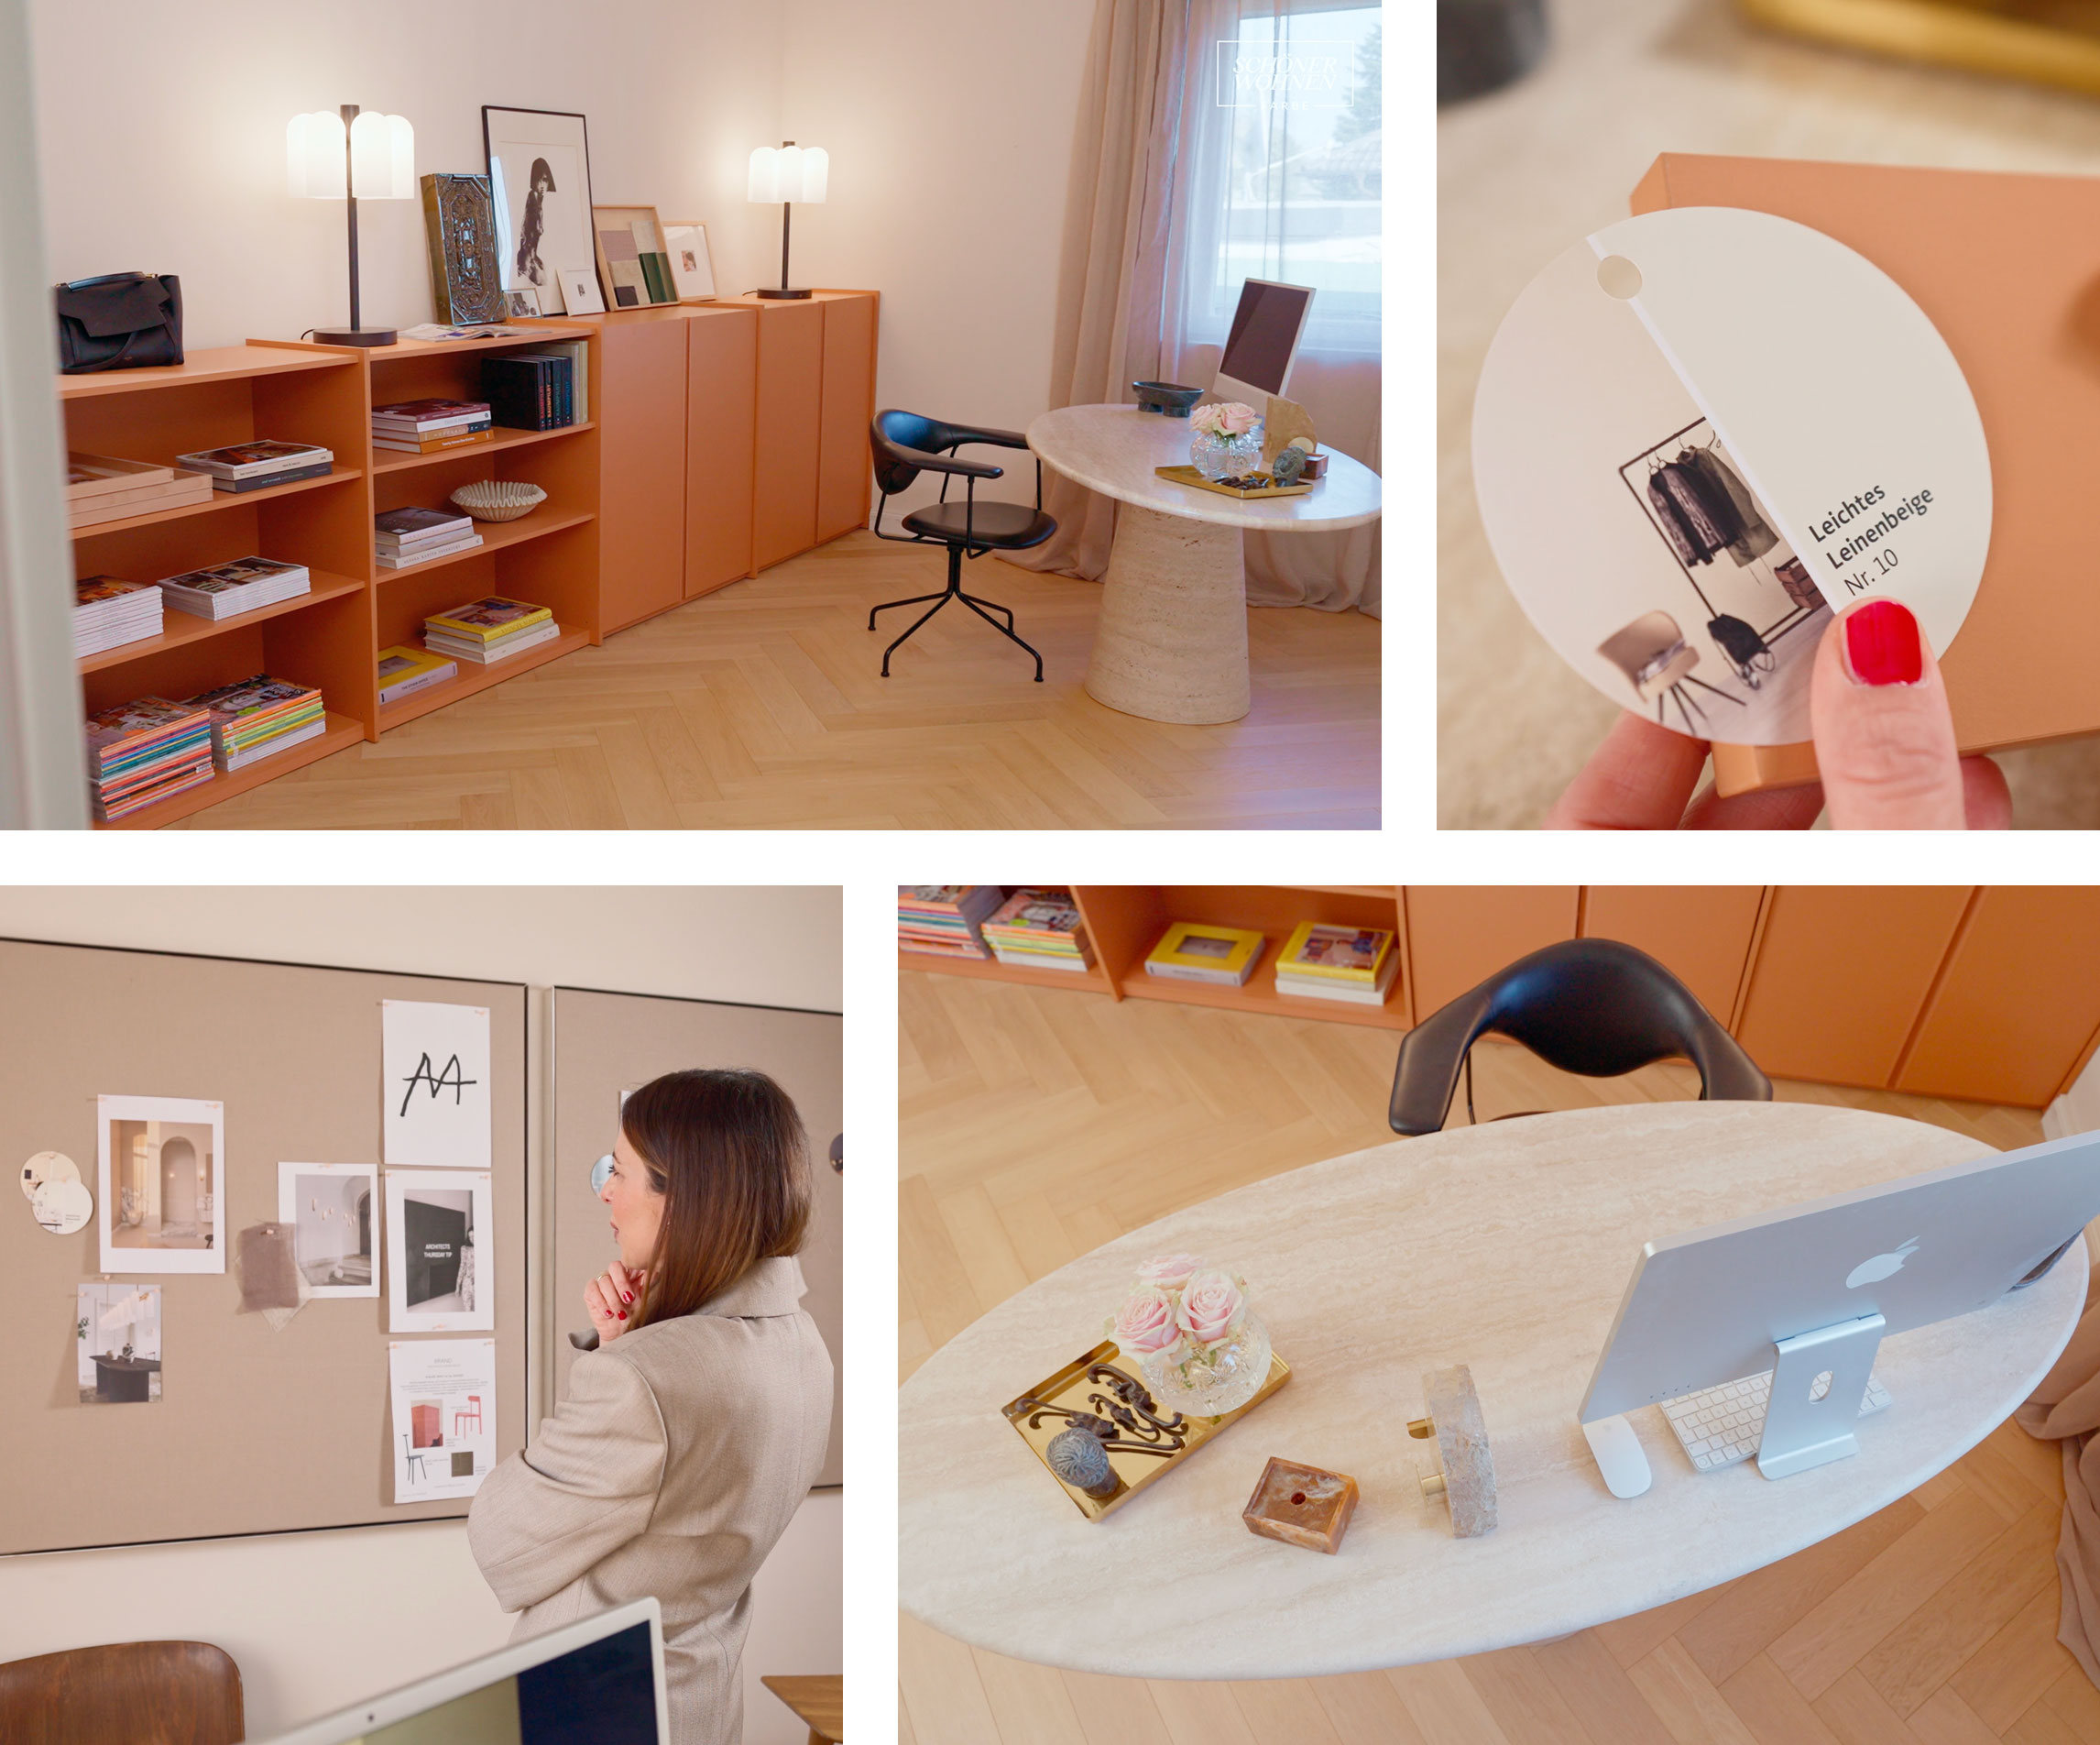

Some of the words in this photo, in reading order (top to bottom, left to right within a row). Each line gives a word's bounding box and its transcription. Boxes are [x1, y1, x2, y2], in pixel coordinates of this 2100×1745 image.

[1809, 485, 1886, 543] Leichtes
[1826, 488, 1934, 570] Leinenbeige
[1843, 571, 1876, 596] Nr.
[1873, 548, 1898, 576] 10
